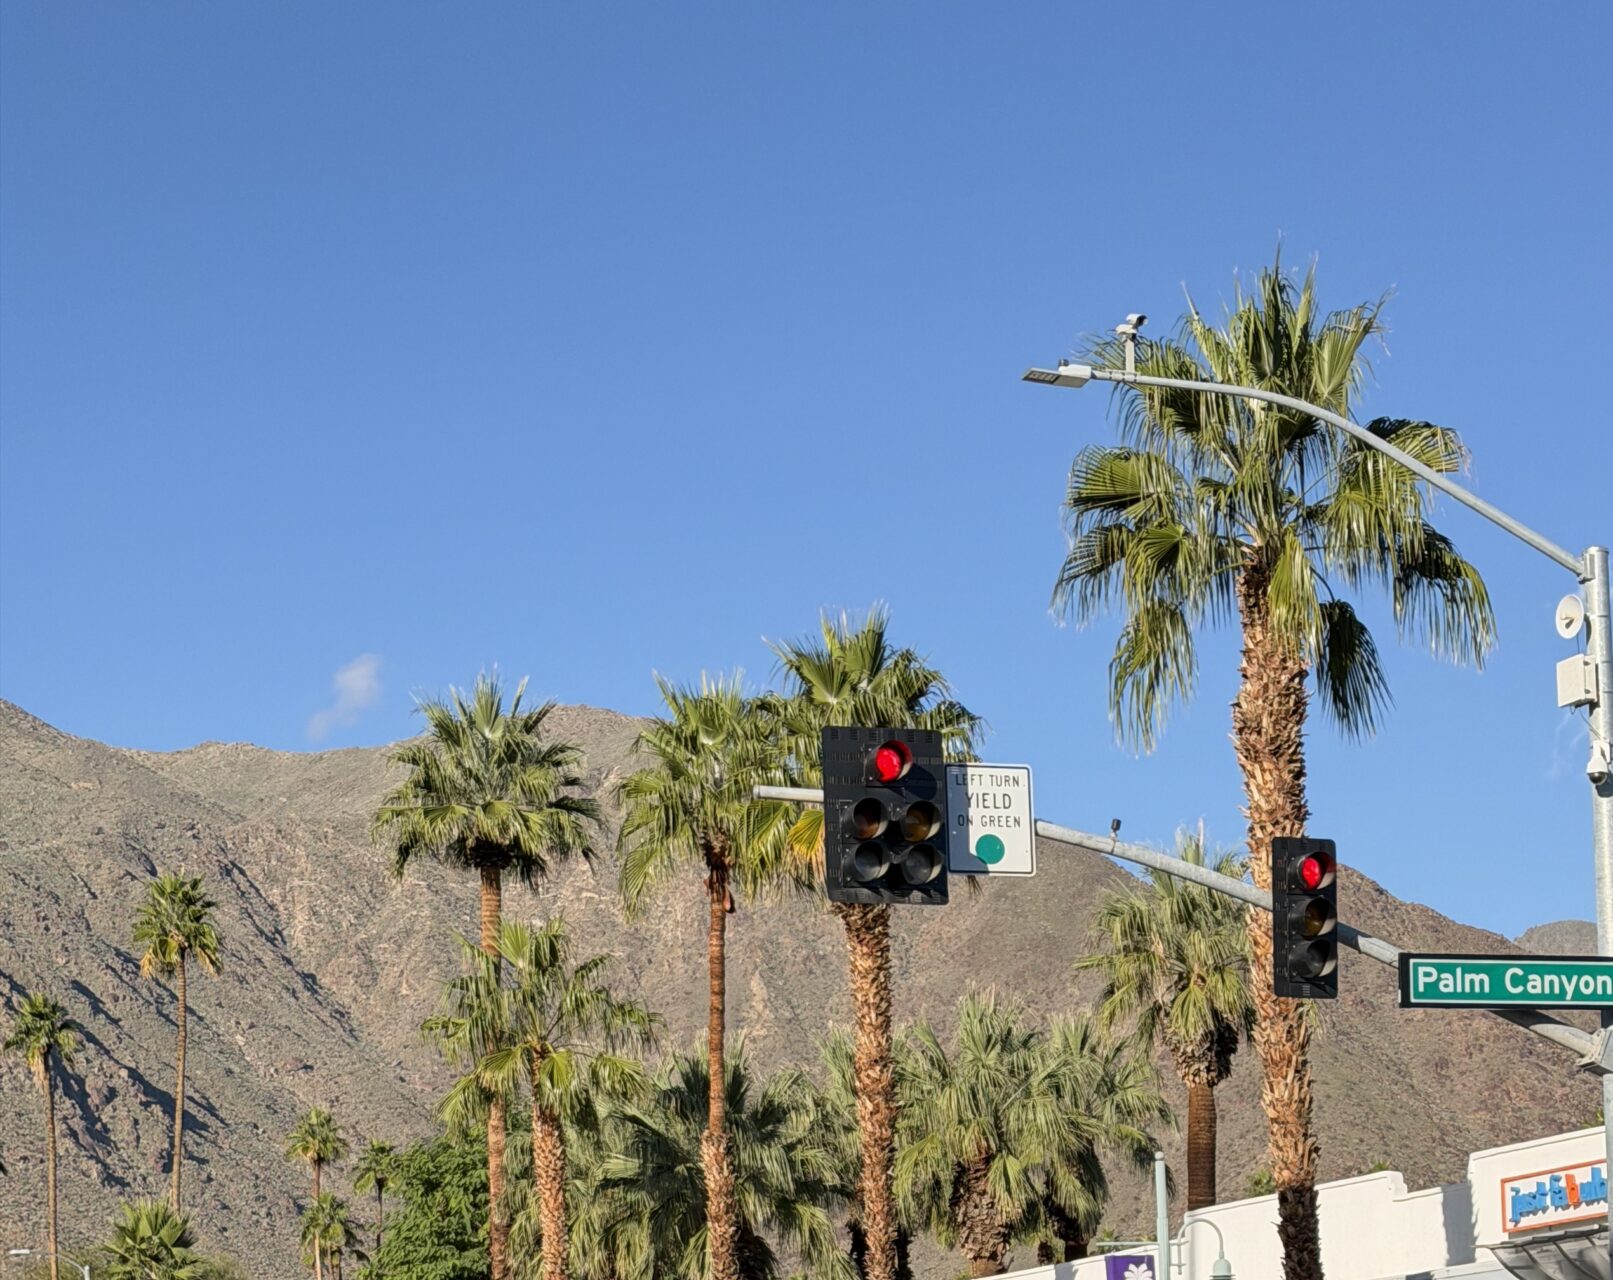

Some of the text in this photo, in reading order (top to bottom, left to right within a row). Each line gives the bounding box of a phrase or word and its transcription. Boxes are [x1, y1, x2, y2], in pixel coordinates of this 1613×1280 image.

[956, 774, 1019, 787] LEFT TURN
[965, 793, 1011, 809] YIELD
[958, 815, 1020, 827] ON GREEN
[1417, 966, 1613, 1001] Palm Canyon
